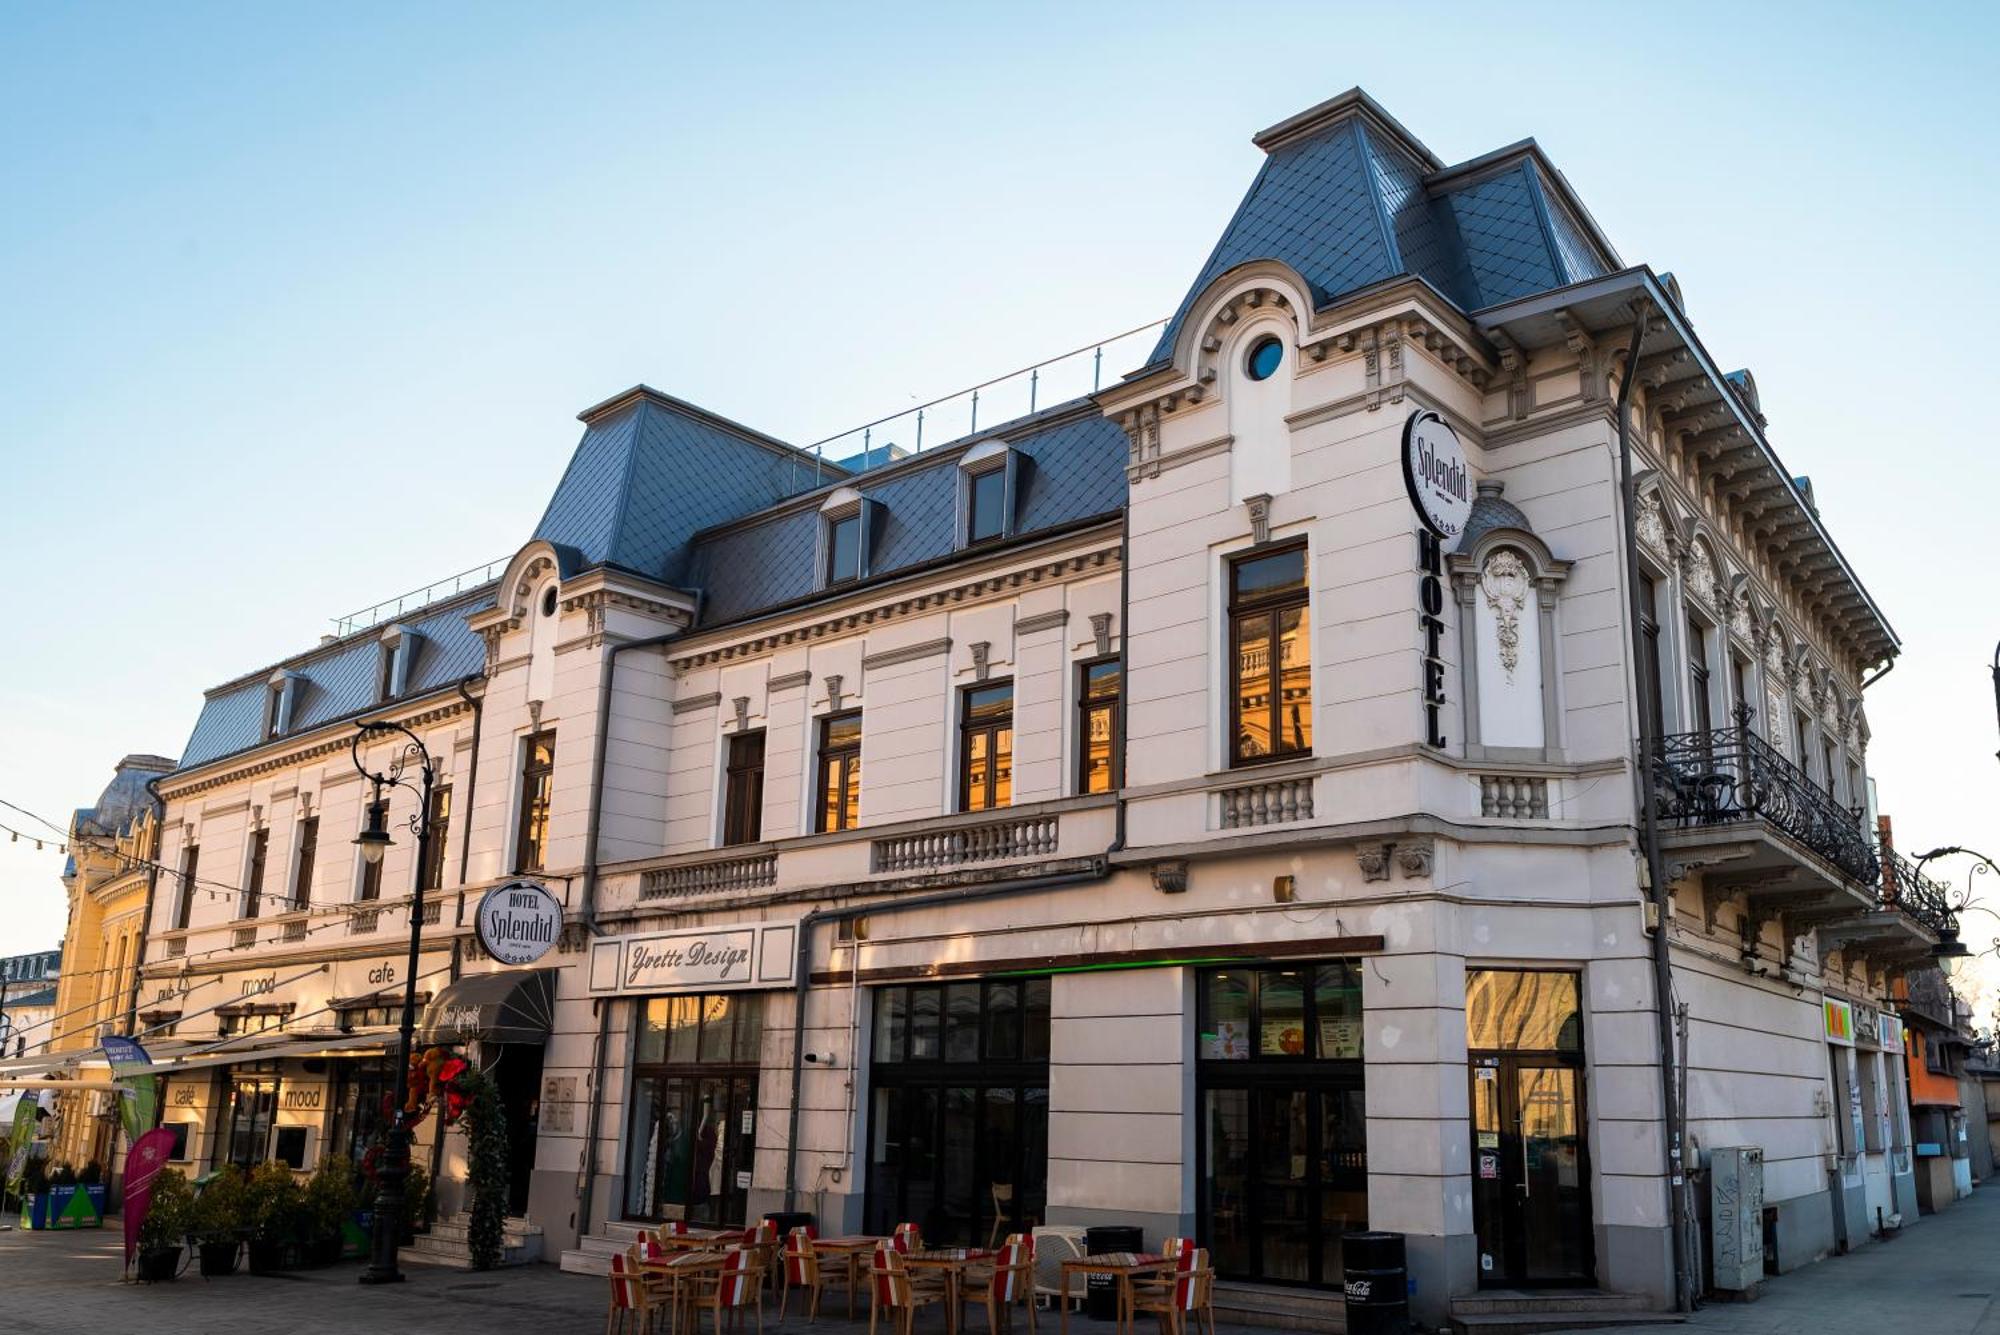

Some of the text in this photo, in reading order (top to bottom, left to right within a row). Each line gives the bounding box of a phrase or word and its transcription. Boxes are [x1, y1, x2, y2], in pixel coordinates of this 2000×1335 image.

[1418, 436, 1467, 504] Splendid
[1418, 527, 1446, 749] HOTEL
[509, 892, 540, 910] HOTEL
[489, 910, 553, 946] Splendid
[368, 961, 395, 984] cafe
[628, 941, 749, 984] Yvette Design
[241, 971, 277, 996] mood
[284, 1084, 321, 1107] mood
